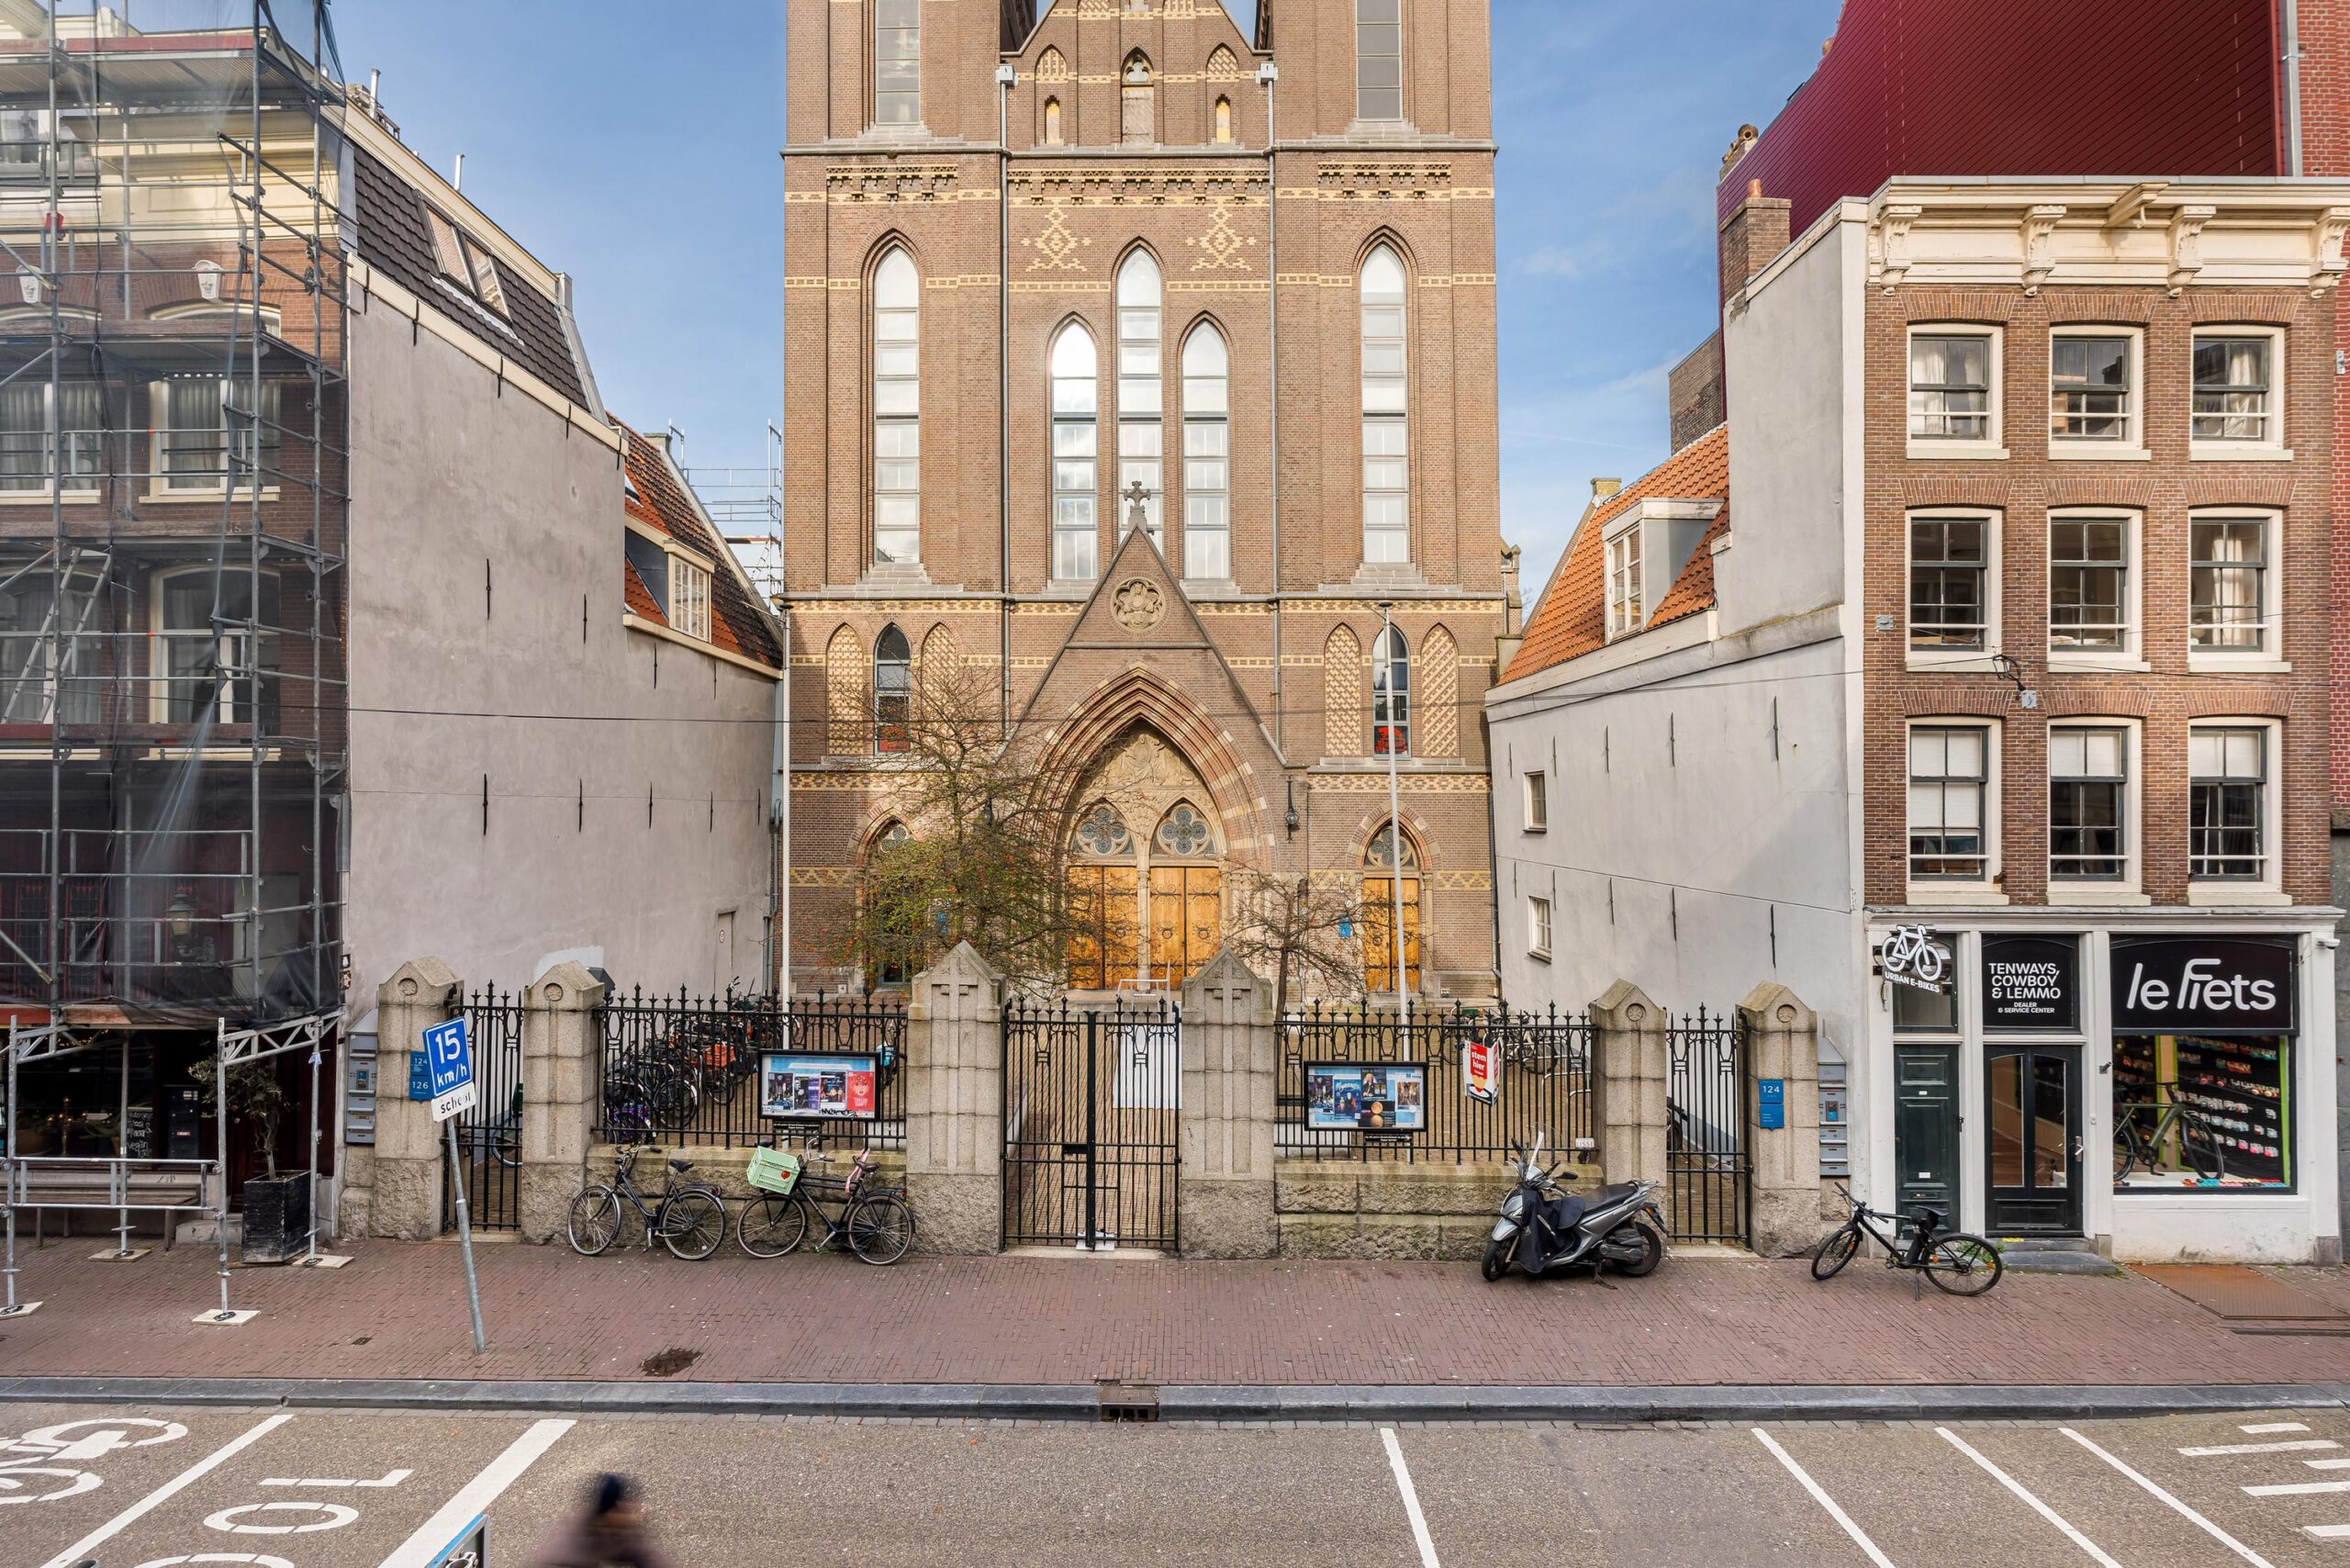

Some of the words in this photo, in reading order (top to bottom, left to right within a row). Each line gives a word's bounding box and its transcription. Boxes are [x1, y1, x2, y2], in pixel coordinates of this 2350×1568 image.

[1988, 962, 2060, 977] TENWAYS,
[1885, 970, 1909, 985] URBAN
[1910, 979, 1941, 993] E-BIKES
[1991, 974, 2057, 987] COWBOY
[2126, 962, 2170, 1011] le
[2177, 958, 2277, 1011] Fiets
[1991, 987, 2003, 999] &
[2007, 987, 2061, 999] LEMMO
[435, 1027, 461, 1064] 15
[1471, 1050, 1487, 1062] stem
[1472, 1058, 1485, 1070] hier
[436, 1063, 467, 1088] km/h
[412, 1081, 429, 1090] 126
[1762, 1085, 1780, 1093] 124
